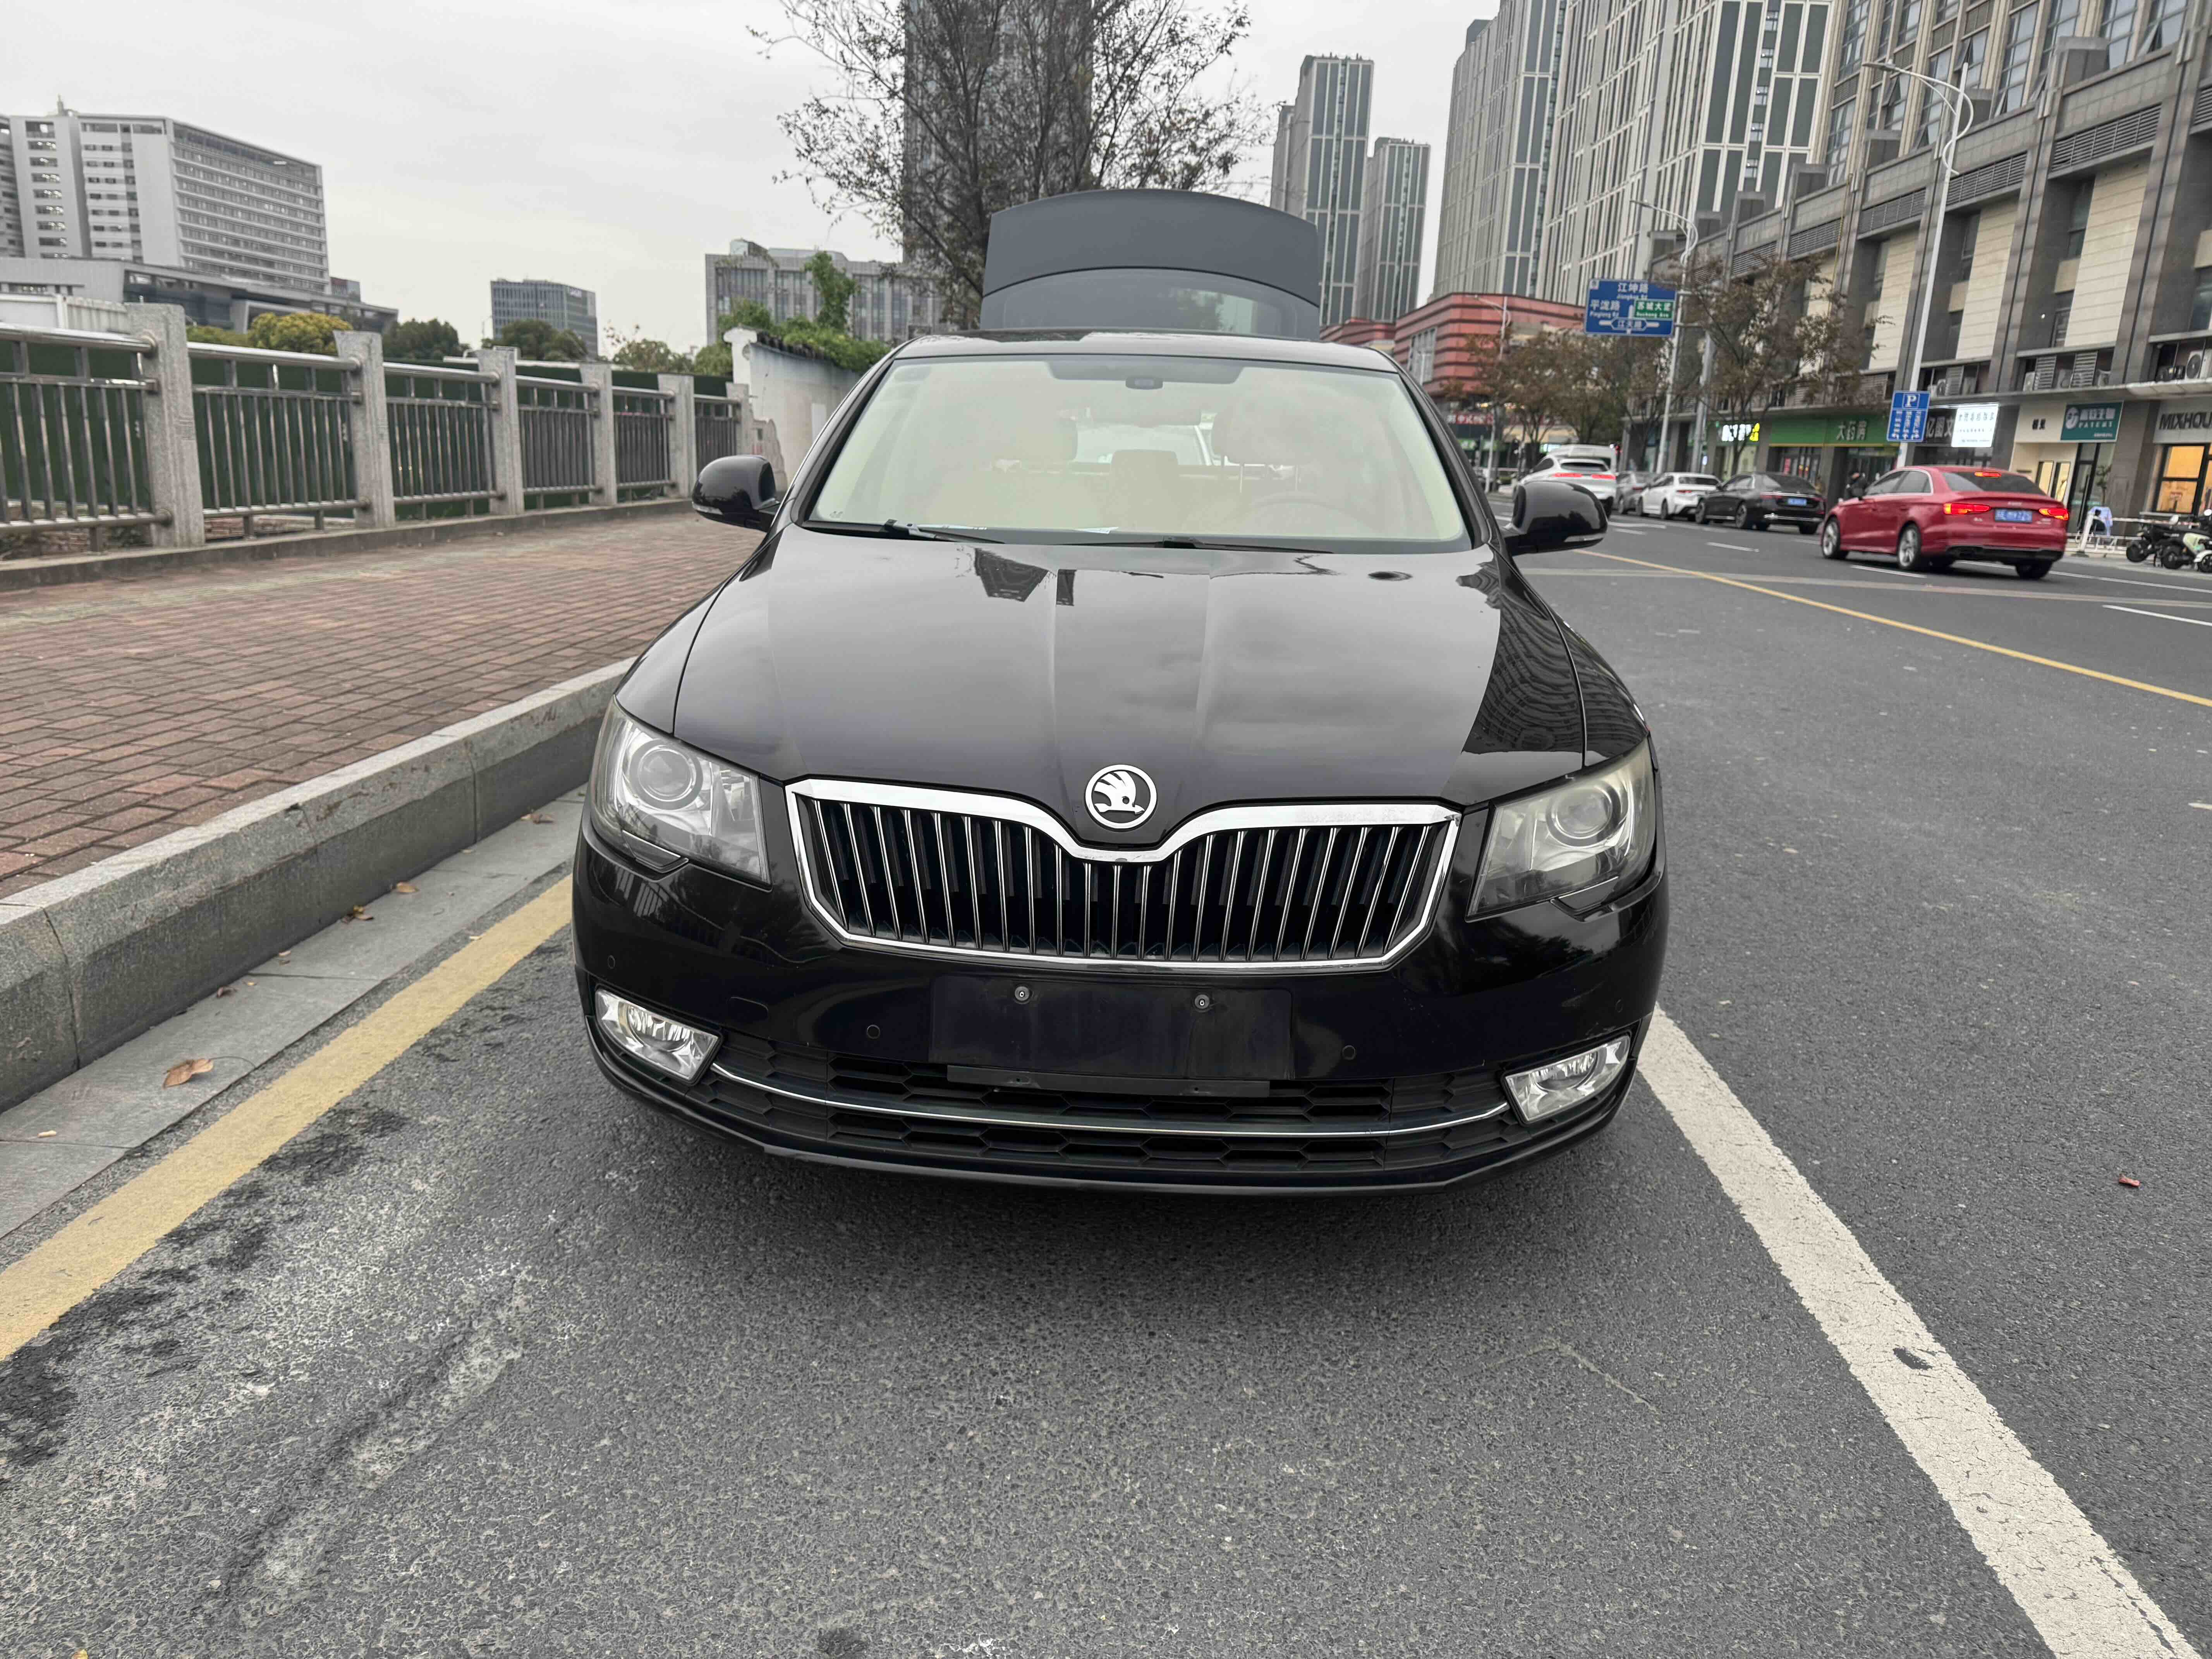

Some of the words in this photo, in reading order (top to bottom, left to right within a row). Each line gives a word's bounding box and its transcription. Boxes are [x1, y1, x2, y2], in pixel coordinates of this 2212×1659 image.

[1905, 395, 1917, 407] P
[1836, 421, 1867, 440] 大药房
